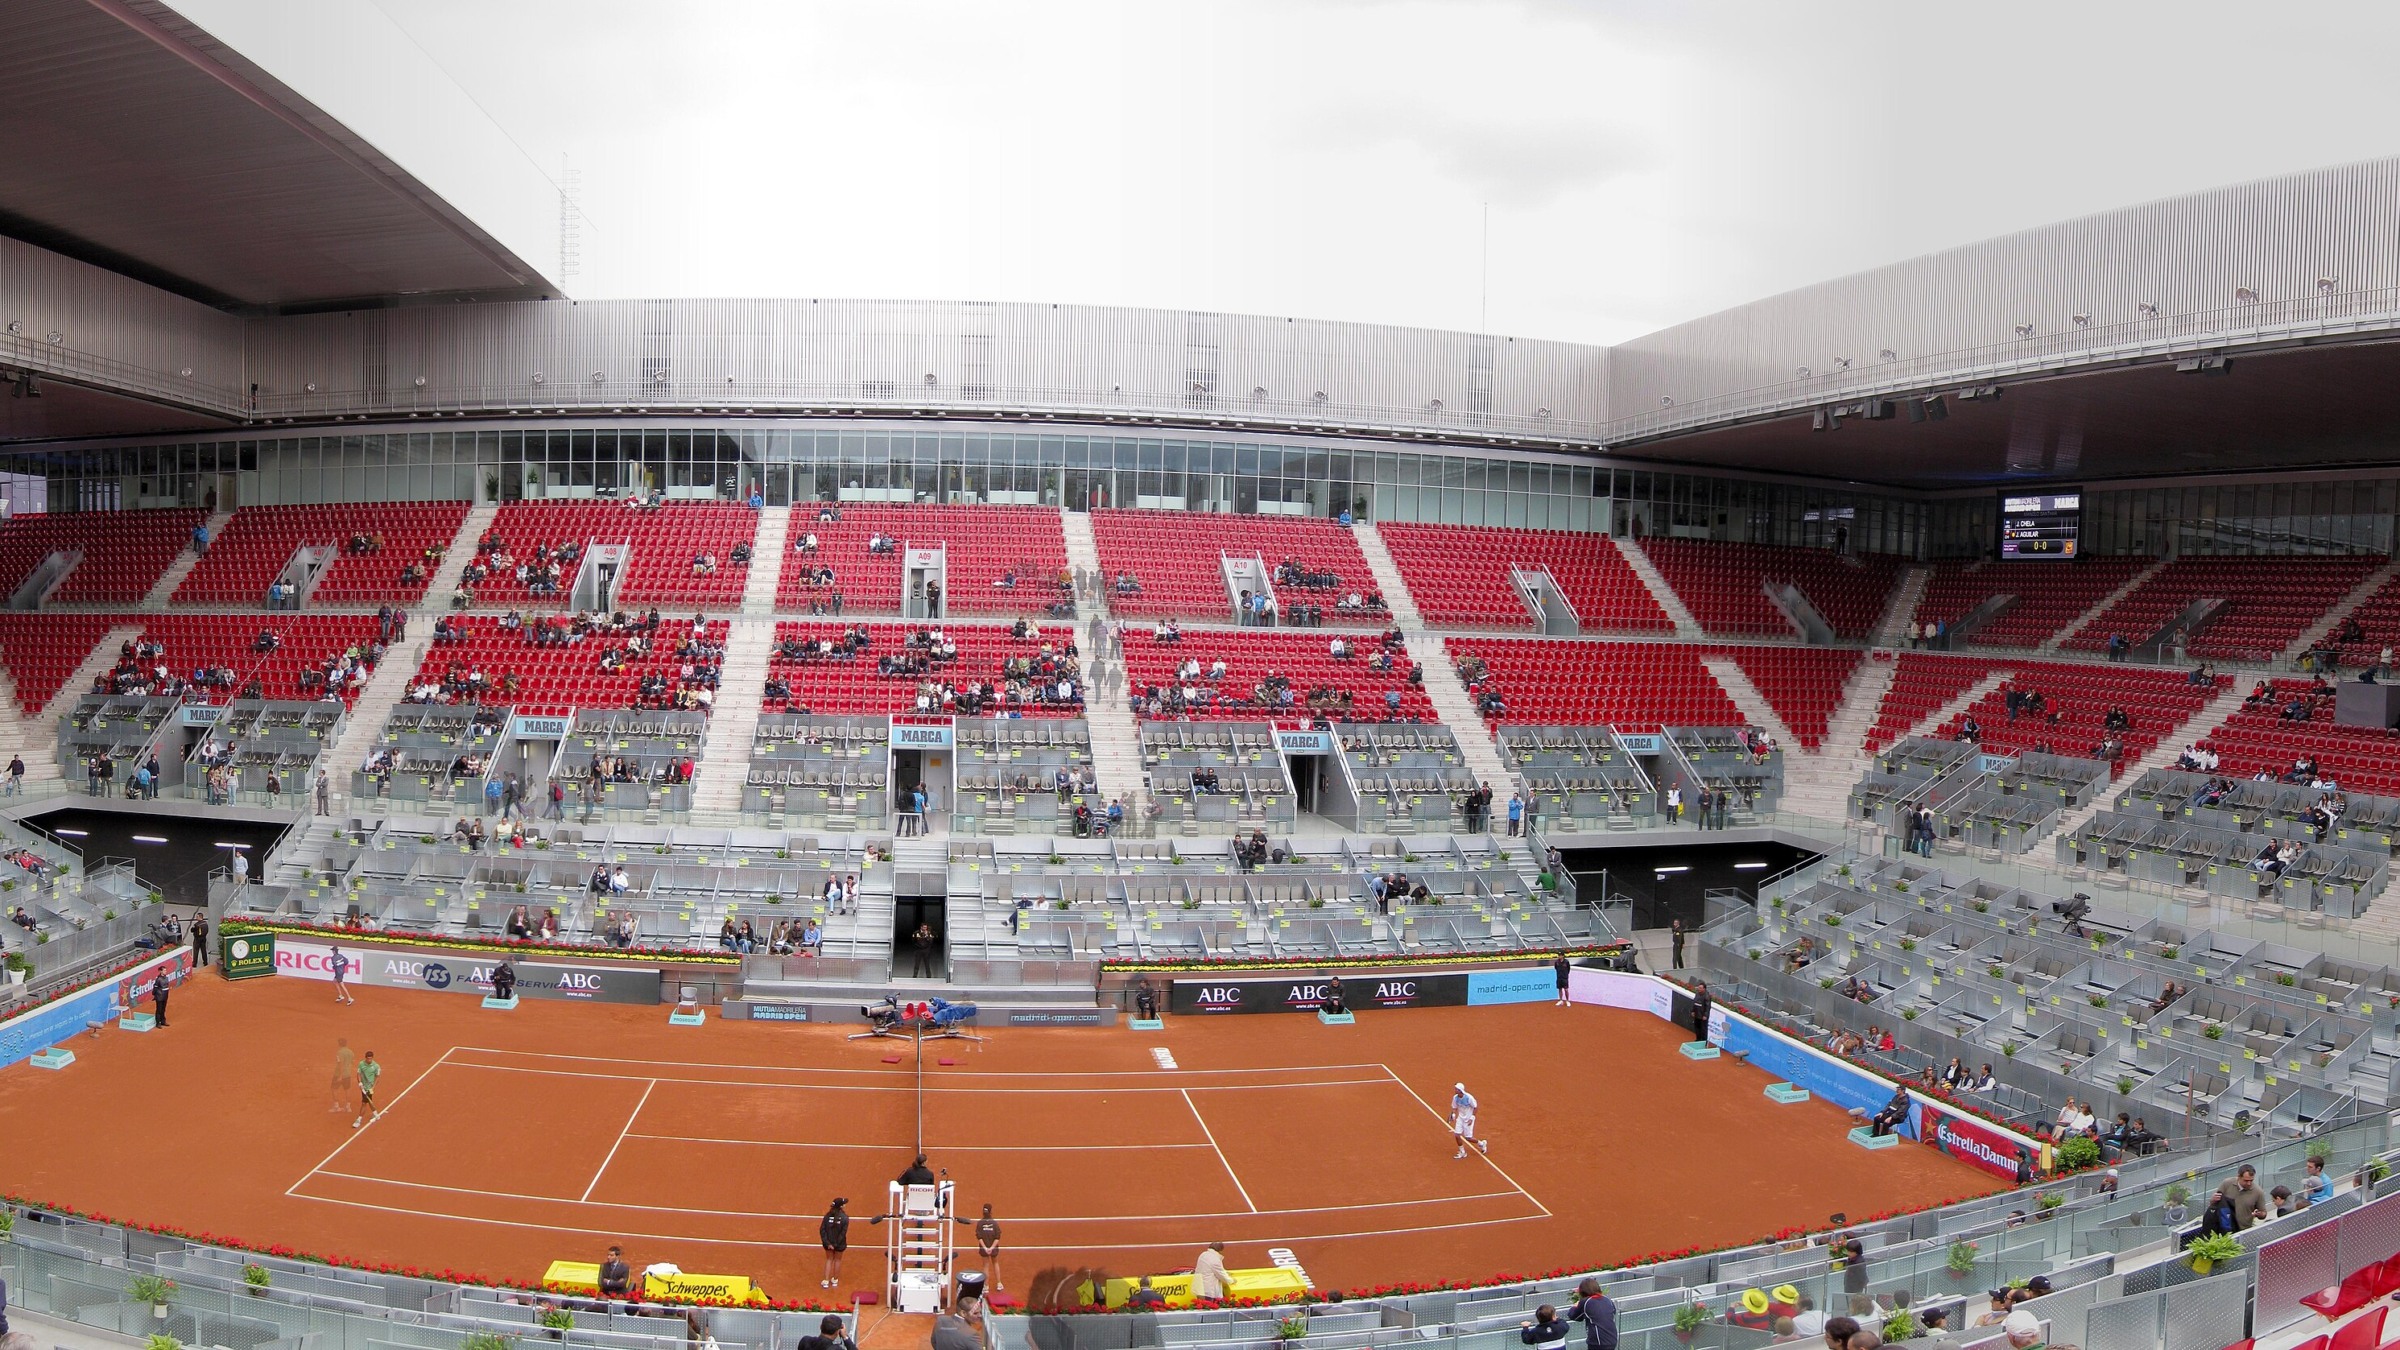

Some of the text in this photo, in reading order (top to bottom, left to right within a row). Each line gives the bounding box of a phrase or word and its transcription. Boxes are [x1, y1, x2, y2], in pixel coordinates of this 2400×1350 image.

[918, 552, 932, 560] A09
[1234, 561, 1248, 569] A10
[524, 720, 564, 733] MARCA
[901, 730, 943, 743] MARCA
[1281, 736, 1320, 748] MARCA
[238, 958, 263, 966] ROLEX
[275, 950, 360, 975] RICOH
[384, 960, 424, 977] ABC
[424, 968, 449, 983] ISS
[558, 973, 601, 990] ABC
[1197, 988, 1240, 1002] ABC
[1288, 985, 1329, 1000] ABC
[1375, 982, 1416, 998] ABC
[1477, 982, 1550, 994] madrid-open.com
[1872, 1137, 1896, 1146] PROSEGUR
[1937, 1123, 2018, 1173] Estrella Damm
[663, 1281, 729, 1298] Schweppes
